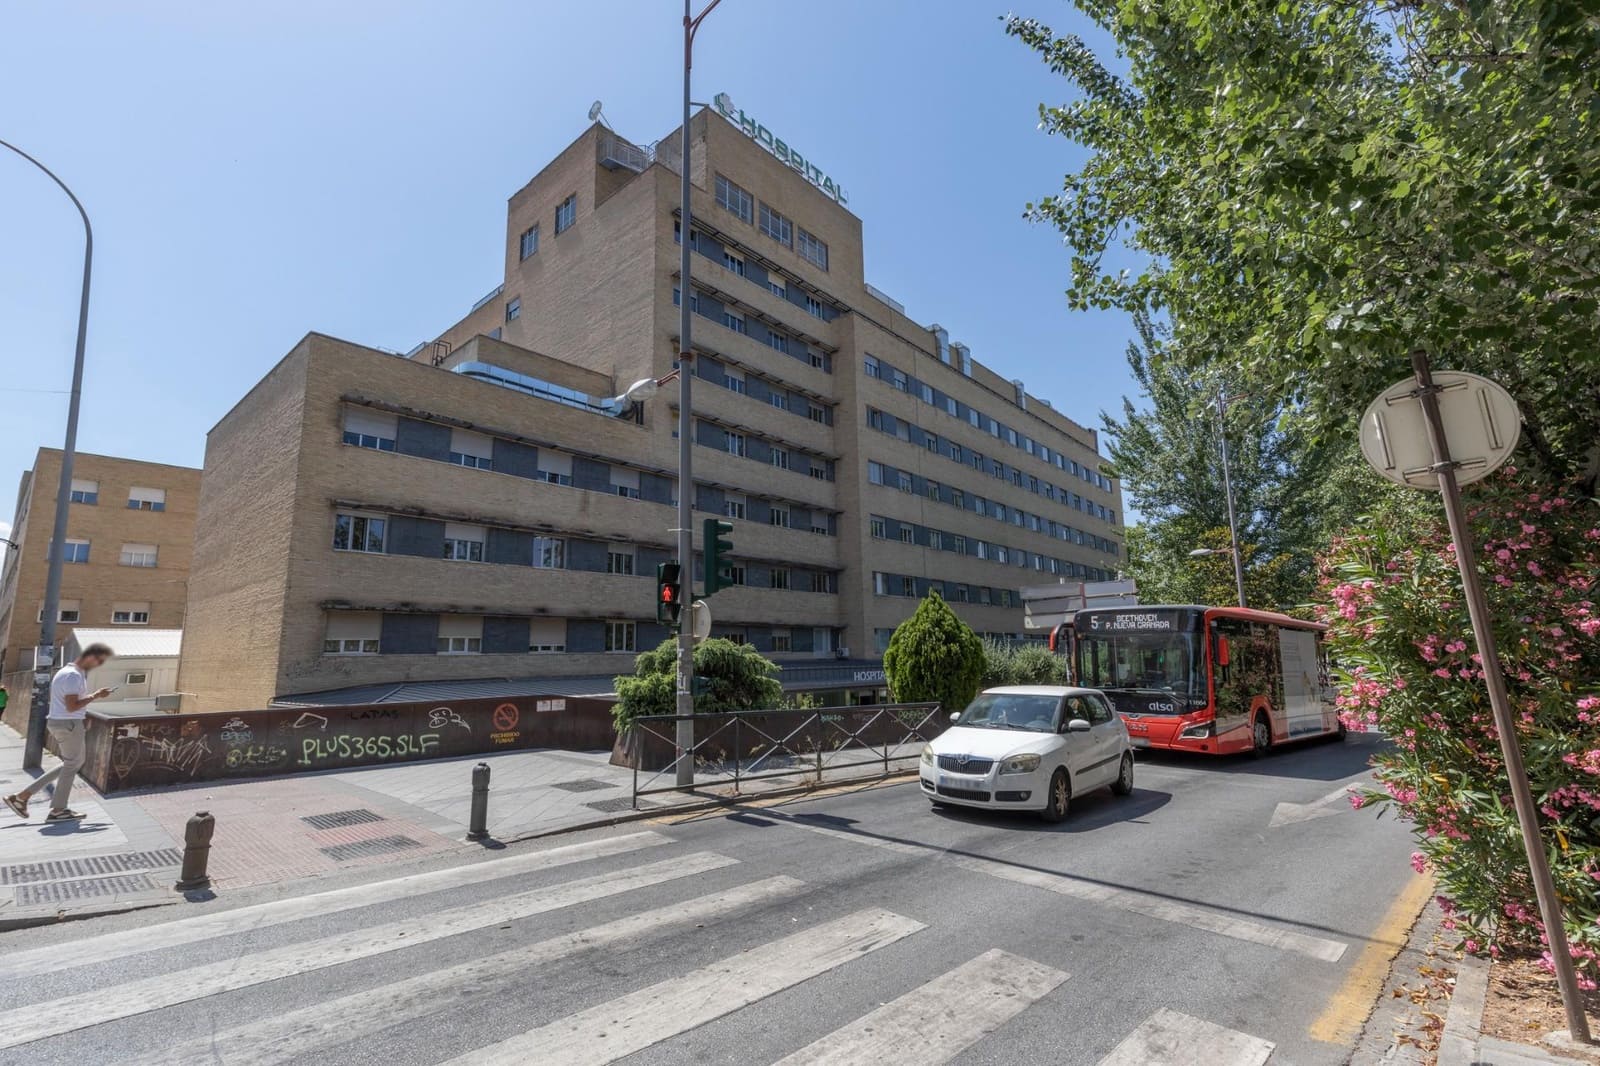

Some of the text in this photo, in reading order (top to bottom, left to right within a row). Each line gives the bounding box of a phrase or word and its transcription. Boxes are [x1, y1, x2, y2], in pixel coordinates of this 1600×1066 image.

[739, 109, 848, 204] HOSPITAL
[1091, 616, 1099, 629] 5
[1116, 614, 1158, 622] BEETHOVEN
[1114, 621, 1137, 629] NUEVA
[1137, 621, 1170, 629] GRANADA
[854, 671, 886, 681] HOSPITA
[1148, 701, 1174, 712] alsa
[298, 735, 439, 764] PLUS365.SLF
